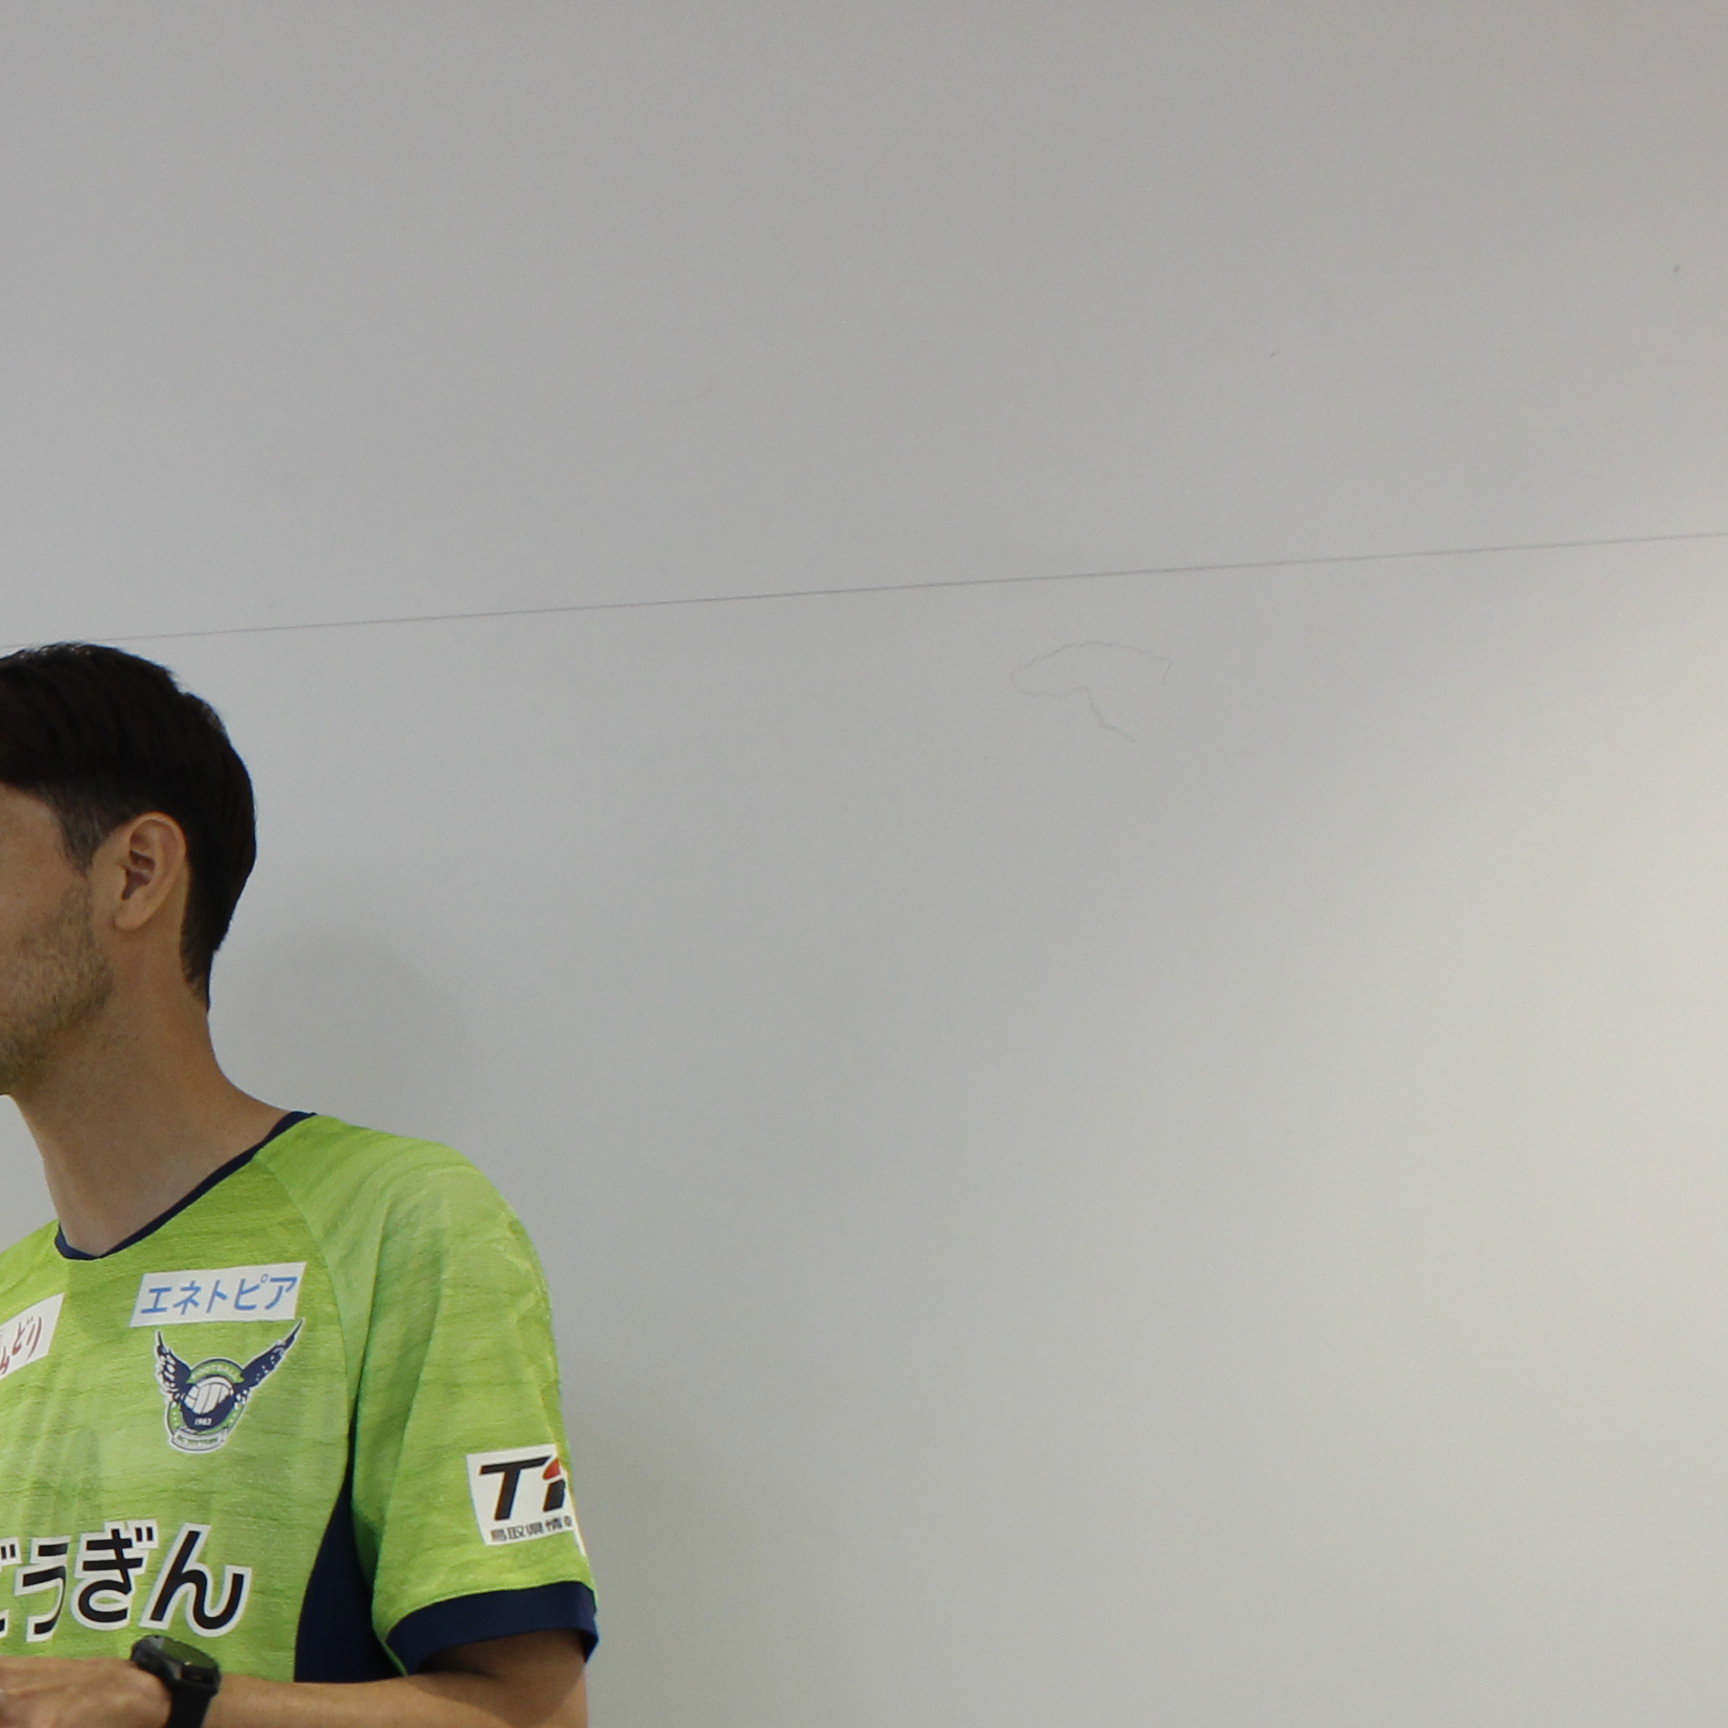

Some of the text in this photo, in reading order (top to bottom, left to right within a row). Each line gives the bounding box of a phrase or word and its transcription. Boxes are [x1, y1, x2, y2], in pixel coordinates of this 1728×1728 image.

[140, 1273, 298, 1316] エネトピア
